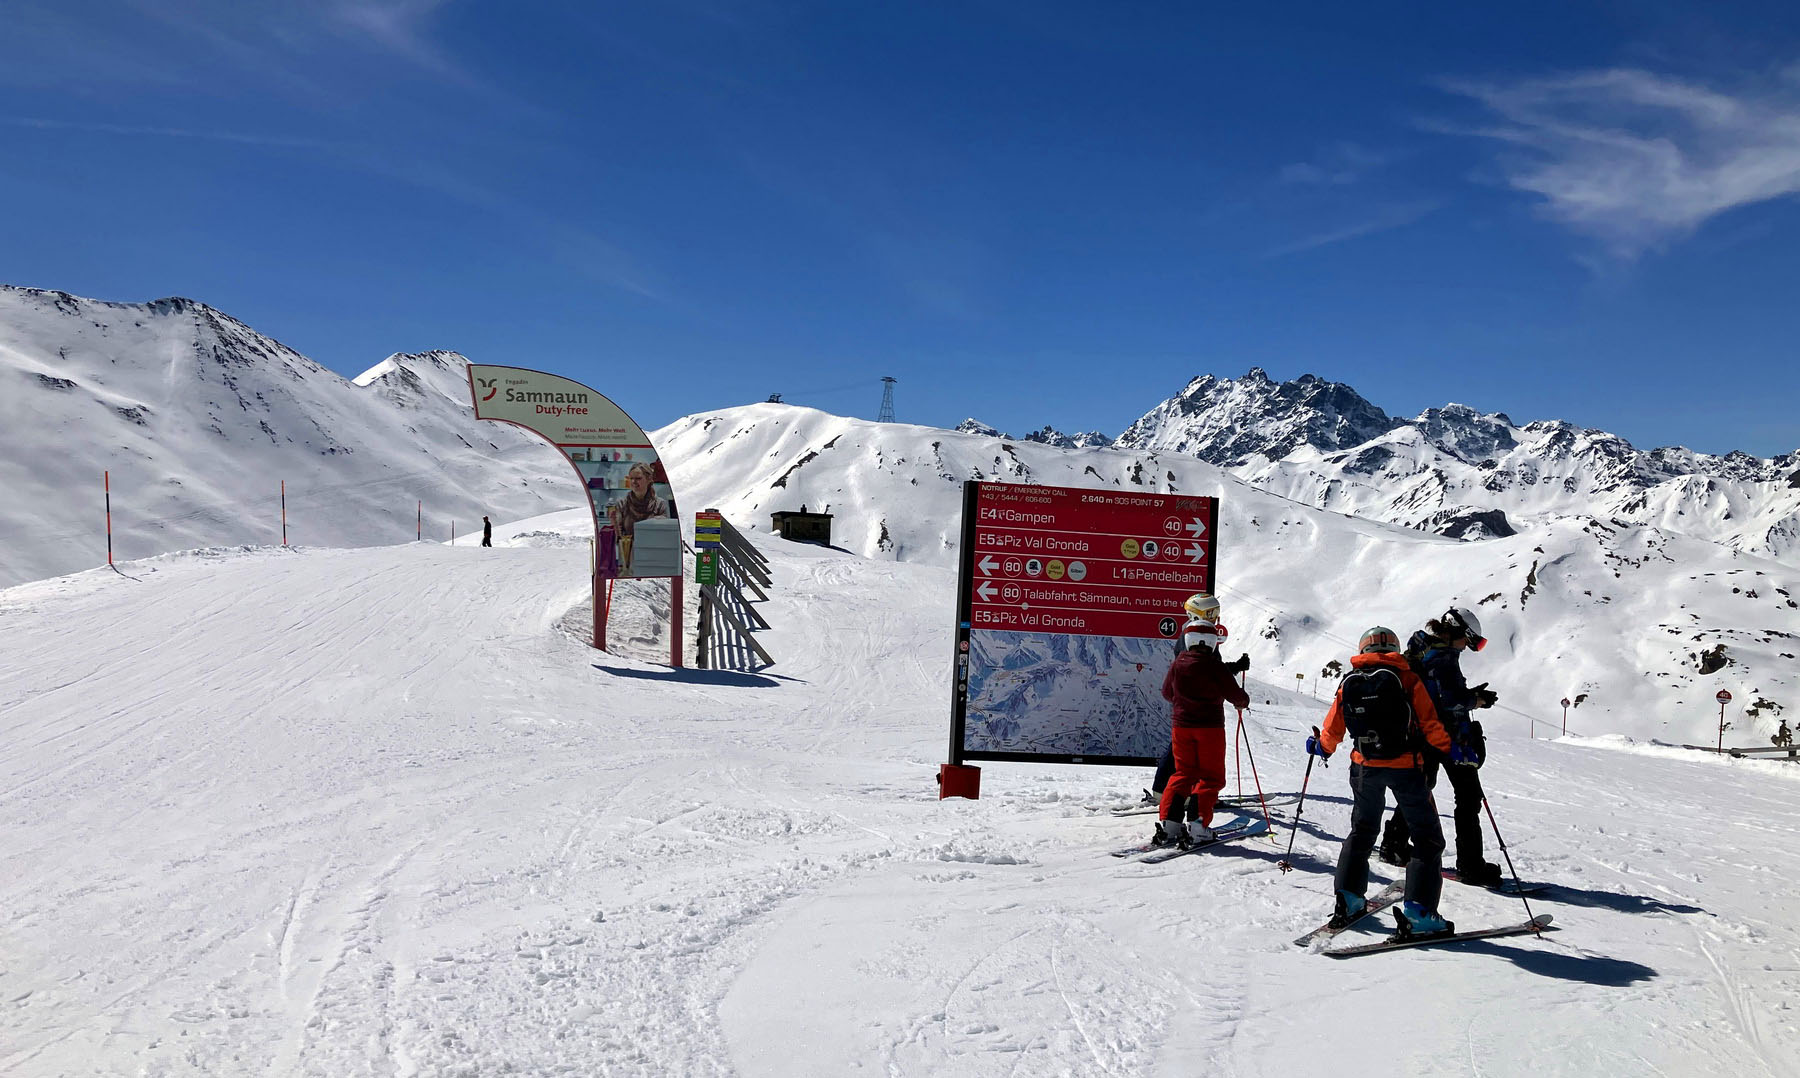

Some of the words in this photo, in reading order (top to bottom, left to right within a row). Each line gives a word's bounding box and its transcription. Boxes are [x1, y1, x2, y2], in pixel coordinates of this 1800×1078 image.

[505, 388, 588, 404] Samnaun
[535, 404, 588, 417] Duty-free
[981, 484, 1008, 492] NOTRUF
[1014, 487, 1051, 495] EMERGENCY
[1081, 495, 1104, 503] 2.640
[1114, 497, 1130, 505] SOS
[1130, 498, 1153, 506] POINT
[1153, 499, 1165, 507] 57
[980, 507, 997, 520] E4
[1005, 509, 1055, 526] Gampen
[1165, 521, 1181, 532] 40
[979, 533, 996, 545] E5
[1004, 535, 1022, 547] Piz
[1024, 536, 1043, 549] Val
[1045, 537, 1089, 552] Gronda
[1164, 546, 1179, 557] 40
[1005, 562, 1021, 572] 80
[1113, 567, 1127, 579] L1
[1136, 568, 1203, 584] Pendelbahn
[1003, 588, 1020, 598] 80
[1023, 588, 1078, 602] Talabfahrt
[1135, 597, 1151, 606] run
[1152, 598, 1162, 607] to
[1163, 599, 1178, 608] the
[975, 611, 992, 623] E5
[1000, 612, 1018, 624] Piz
[1020, 613, 1039, 625] Val
[1041, 614, 1085, 628] Gronda
[1160, 622, 1176, 633] 41
